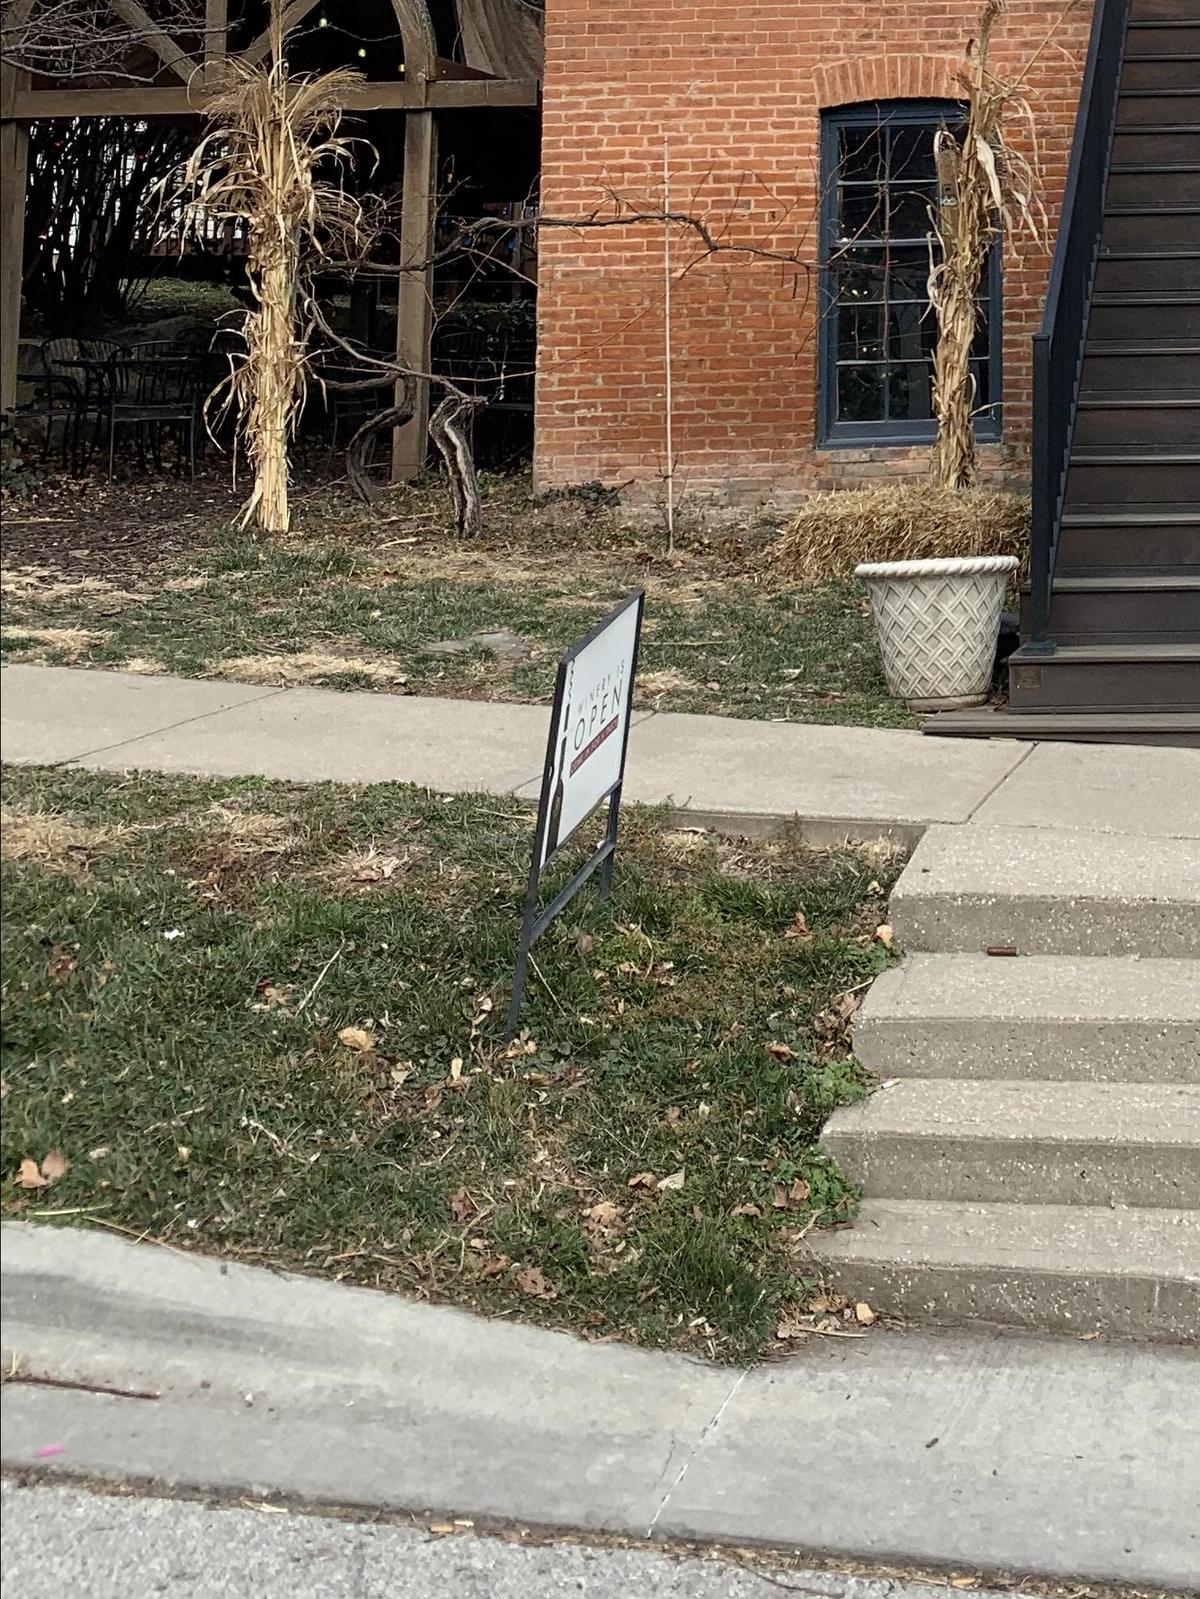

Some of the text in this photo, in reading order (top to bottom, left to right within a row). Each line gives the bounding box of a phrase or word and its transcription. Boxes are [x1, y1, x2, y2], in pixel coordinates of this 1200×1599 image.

[574, 677, 623, 751] OPEN
[577, 658, 625, 715] WINERY IS
